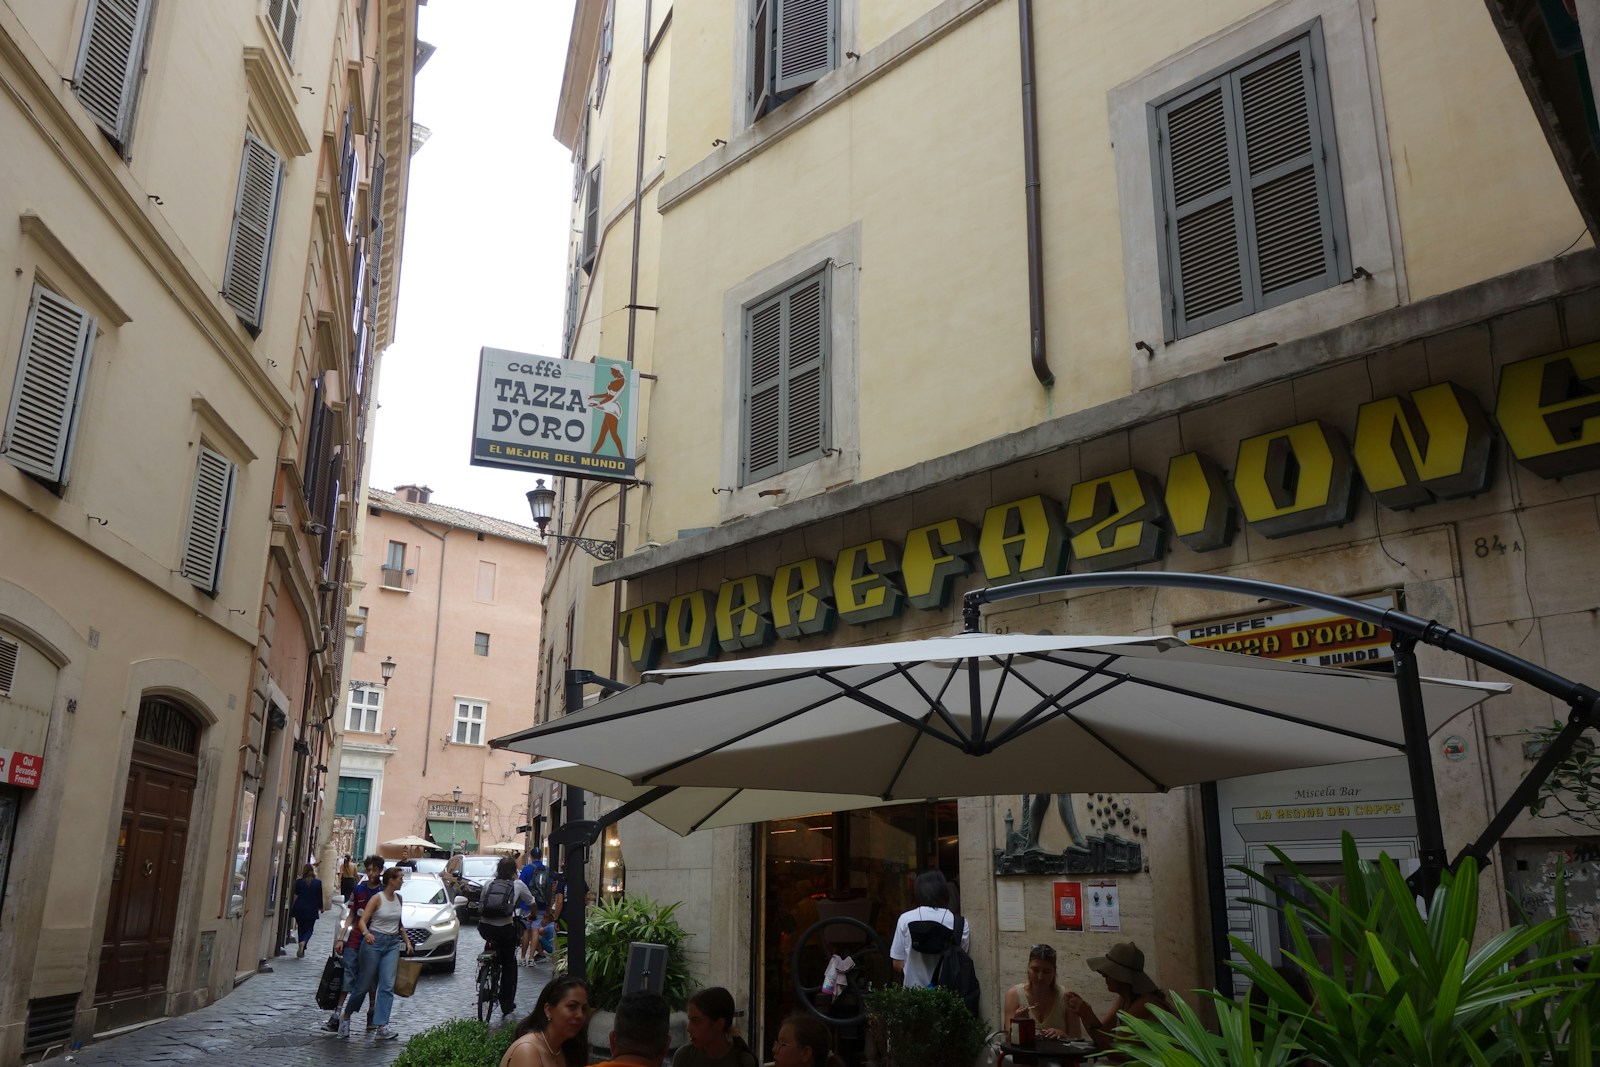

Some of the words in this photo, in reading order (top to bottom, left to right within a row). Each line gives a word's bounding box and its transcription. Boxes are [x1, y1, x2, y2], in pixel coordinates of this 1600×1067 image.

[507, 360, 562, 379] caffè
[494, 378, 587, 413] TAZZA
[491, 408, 585, 442] D'ORO
[489, 444, 502, 455] EL
[505, 446, 549, 460] MEJOR
[554, 453, 577, 465] DEL
[581, 456, 626, 470] MUNDO
[619, 341, 1600, 668] TORREFAZIONE
[1474, 534, 1507, 558] 84
[1291, 621, 1377, 649] D'ORO
[1319, 648, 1379, 666] MUNDO
[15, 765, 38, 777] Bevande
[22, 756, 34, 767] Qui
[14, 774, 35, 786] Fresche
[1294, 785, 1336, 800] Miscela
[1338, 785, 1362, 797] Bar
[1255, 809, 1272, 821] LA
[1276, 807, 1324, 819] REGINA
[1327, 805, 1351, 817] DEI
